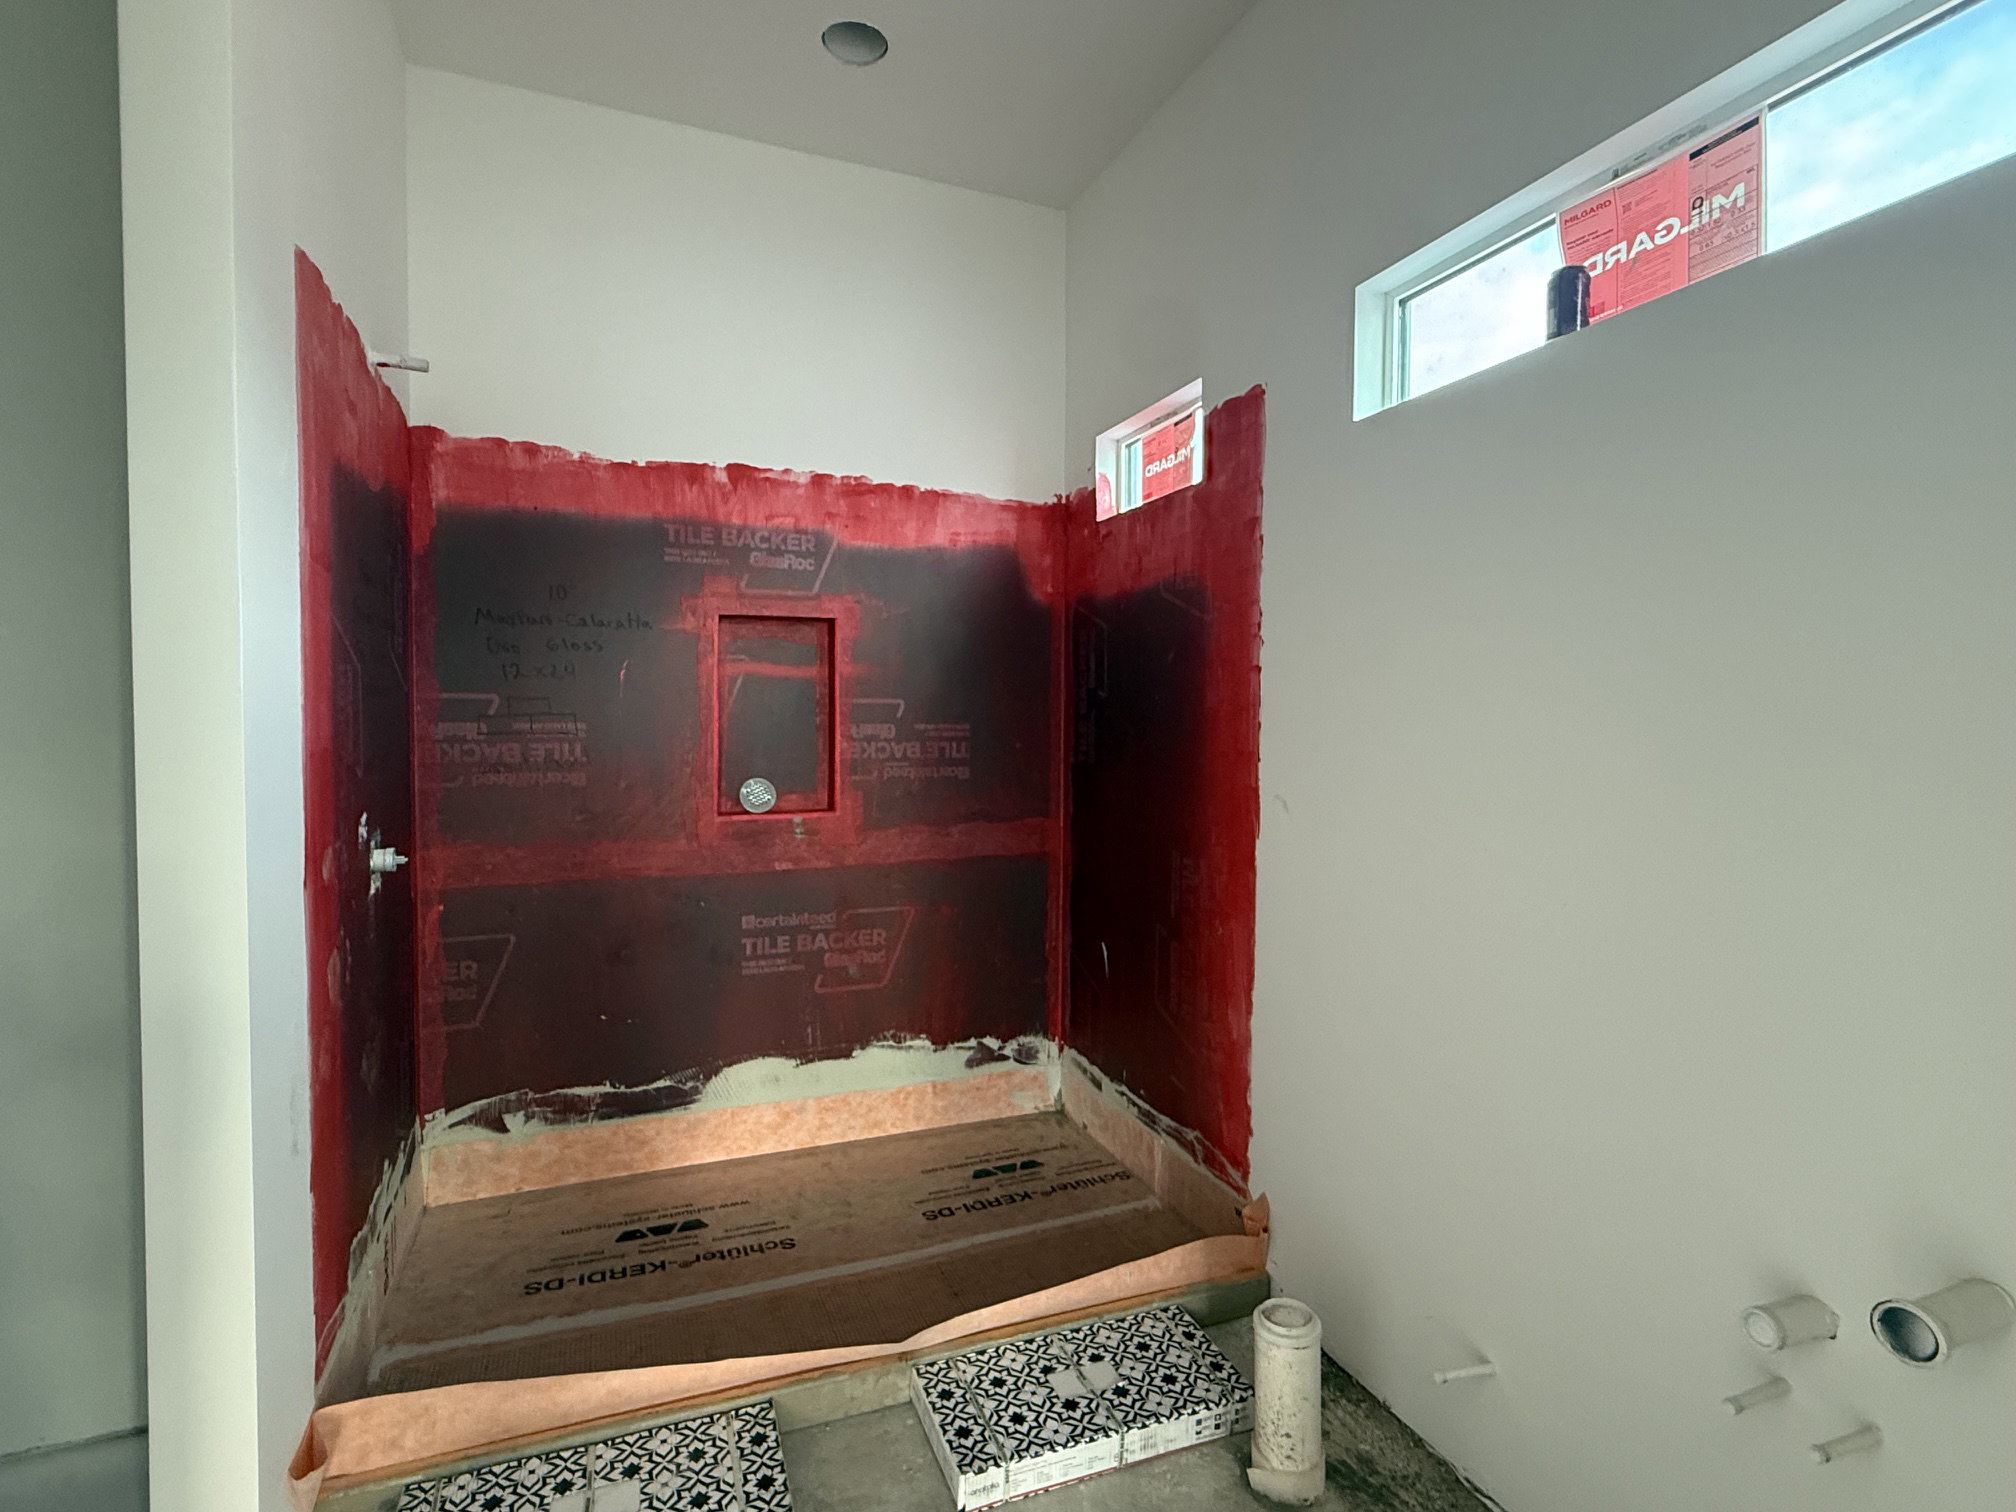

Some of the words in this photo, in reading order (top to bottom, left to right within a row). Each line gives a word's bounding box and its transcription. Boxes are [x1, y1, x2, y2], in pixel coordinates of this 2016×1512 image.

[1564, 199, 1612, 226] MILGARD
[663, 524, 715, 546] TILE
[721, 527, 816, 553] BACKER
[528, 742, 588, 763] TILE
[926, 741, 970, 760] TILE
[741, 935, 792, 957] TILE
[797, 928, 887, 953] BACKER
